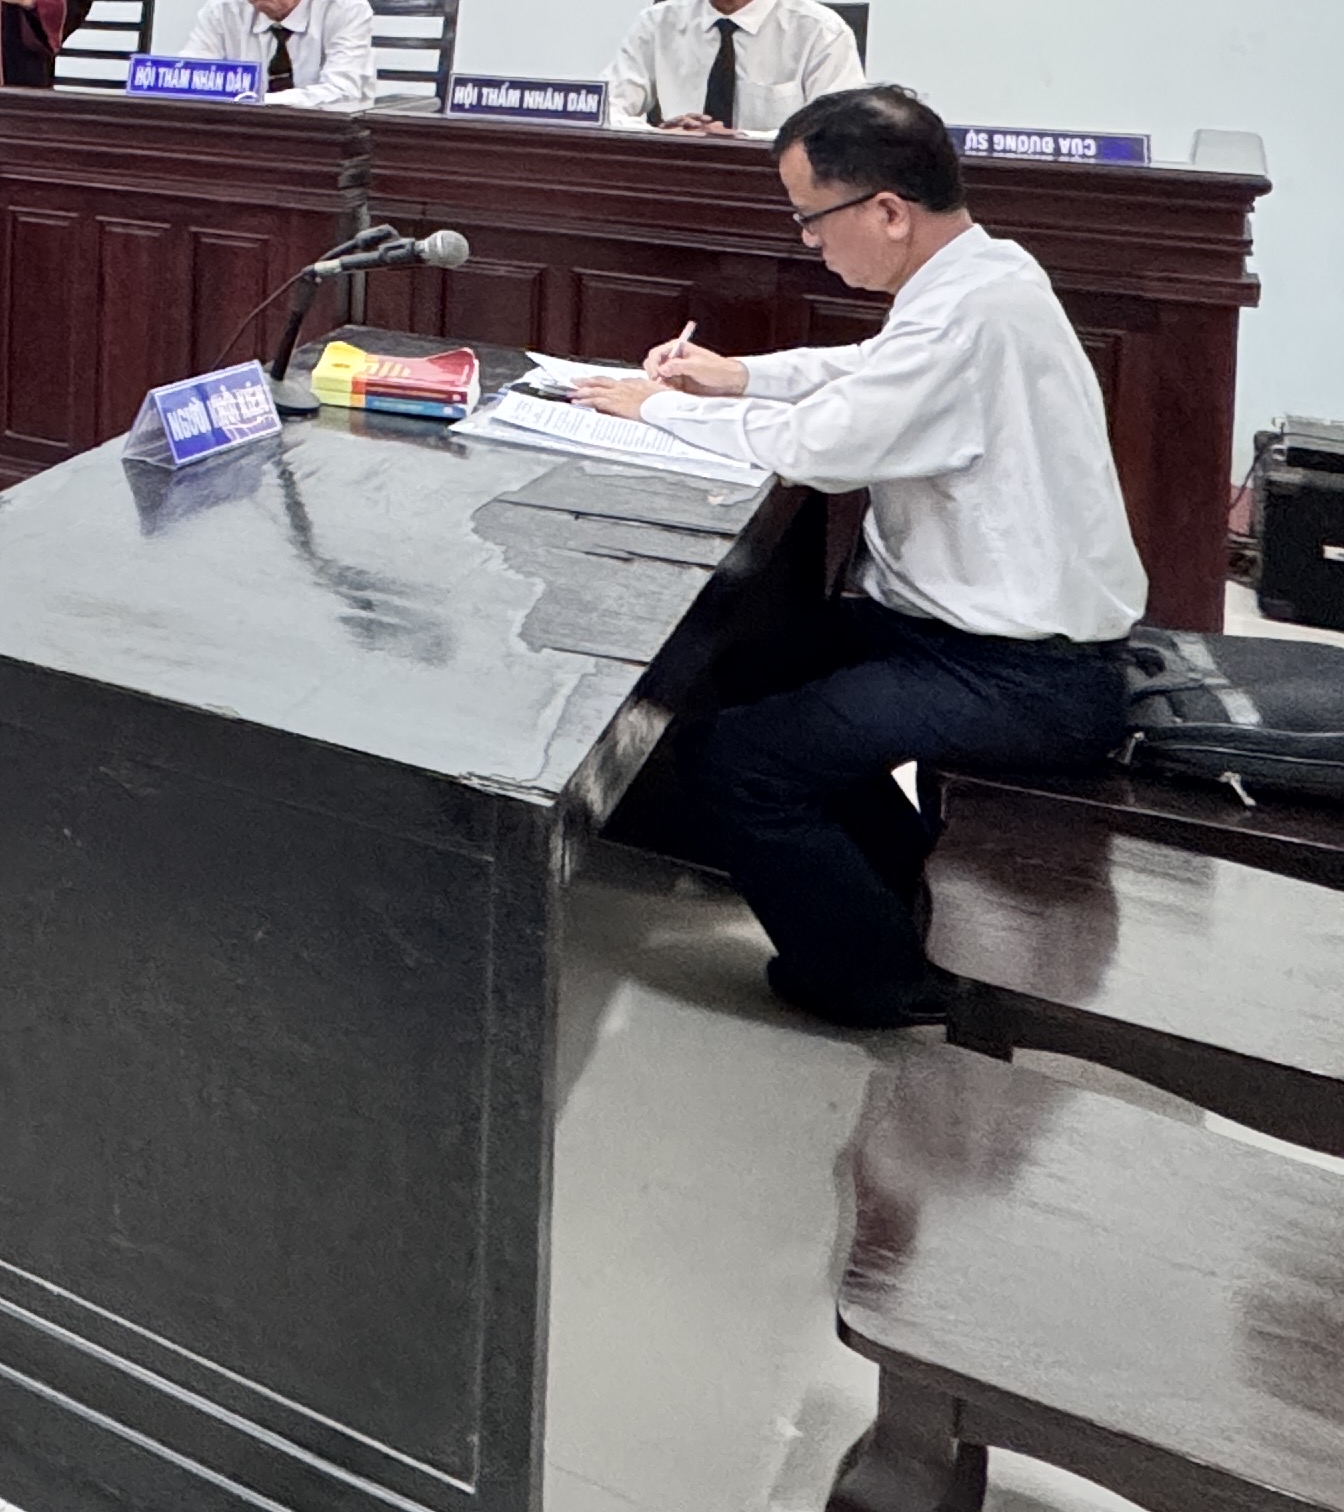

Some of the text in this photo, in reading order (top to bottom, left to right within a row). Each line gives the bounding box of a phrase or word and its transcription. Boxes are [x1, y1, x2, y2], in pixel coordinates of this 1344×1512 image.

[453, 81, 600, 113] HỘI THẨM NHÂN DÂN
